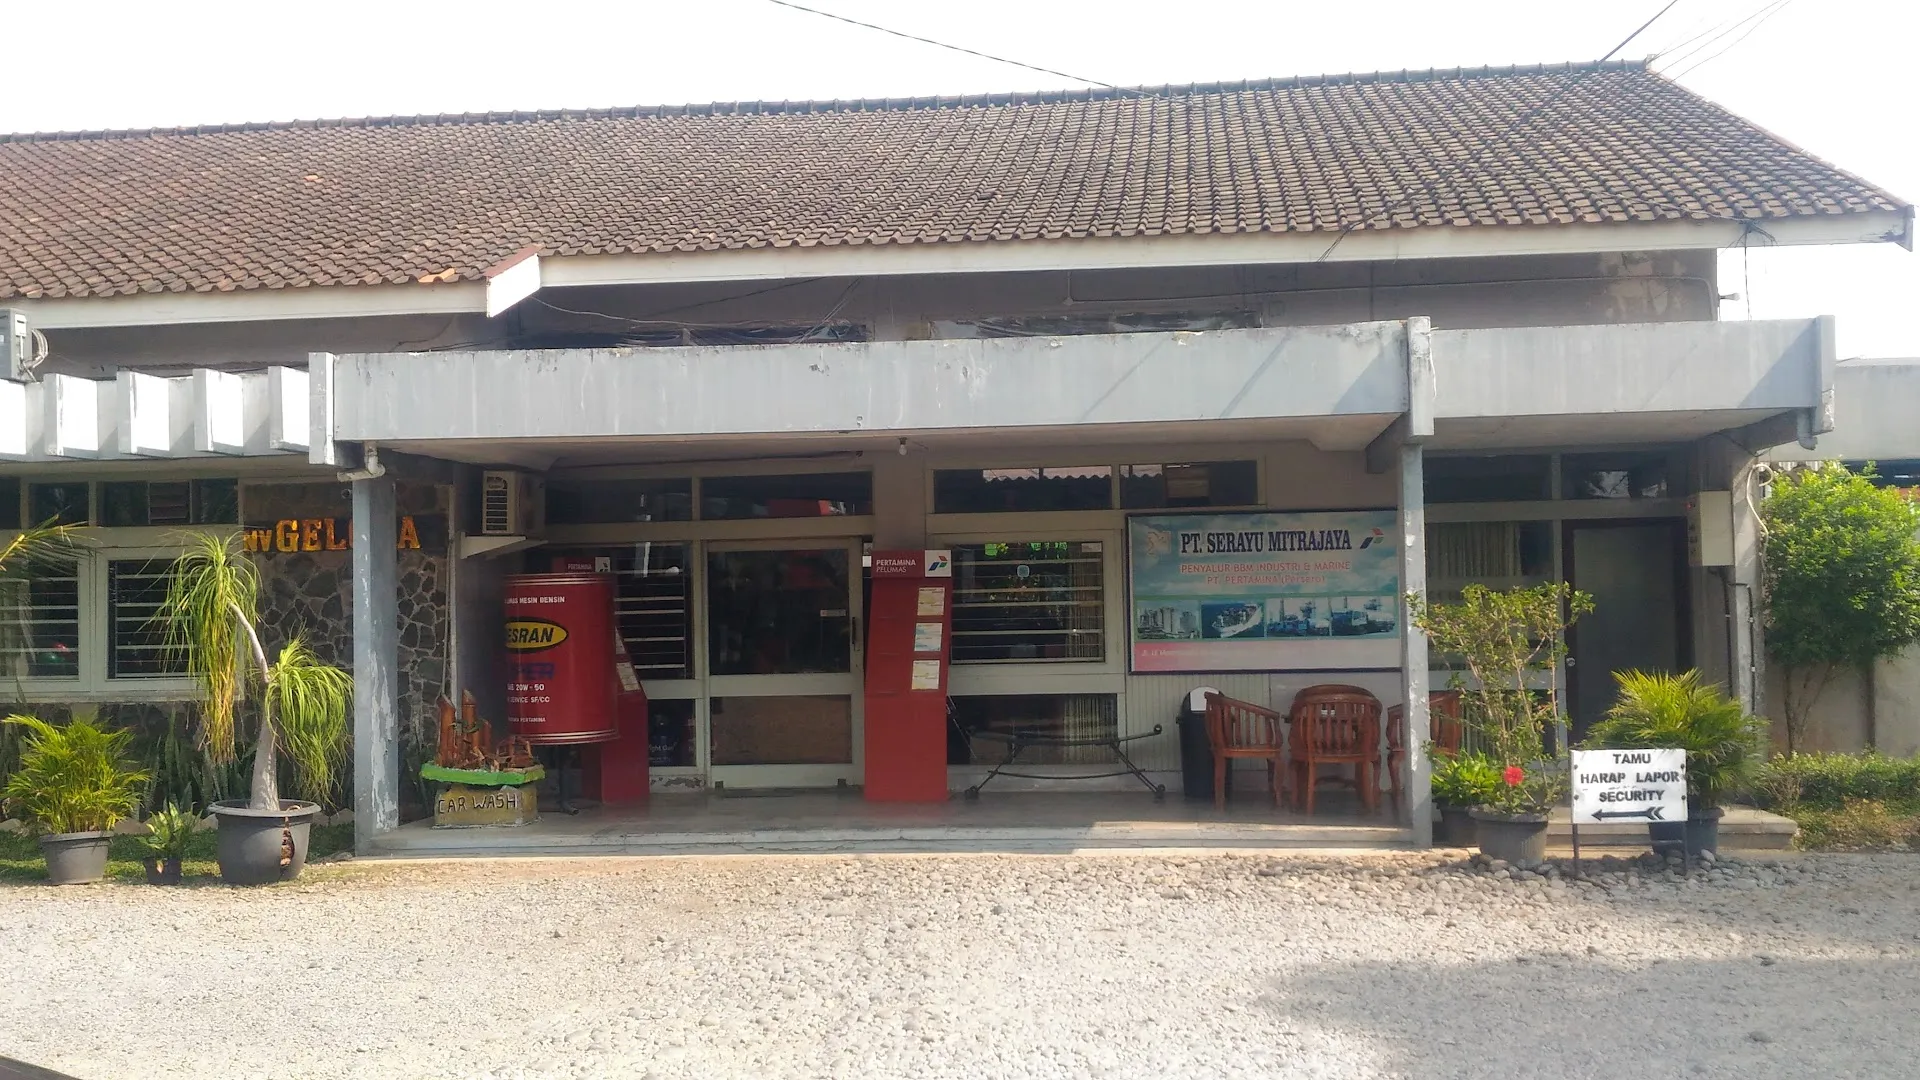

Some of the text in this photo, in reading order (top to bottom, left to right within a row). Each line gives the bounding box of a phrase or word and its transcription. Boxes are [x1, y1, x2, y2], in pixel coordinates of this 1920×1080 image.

[276, 516, 421, 552] GELA
[1181, 529, 1352, 553] PT. SERAYU MITRAJAYA
[1181, 563, 1231, 573] PENYALUR
[1256, 561, 1301, 572] INDUSTRI
[1314, 560, 1351, 571] MARINE
[1225, 574, 1278, 584] PERTAMINA
[1612, 753, 1652, 765] TAMU
[1580, 771, 1680, 784] HARAP LAPOR
[1599, 789, 1666, 802] SECURITY
[438, 792, 519, 814] CAR WASH
